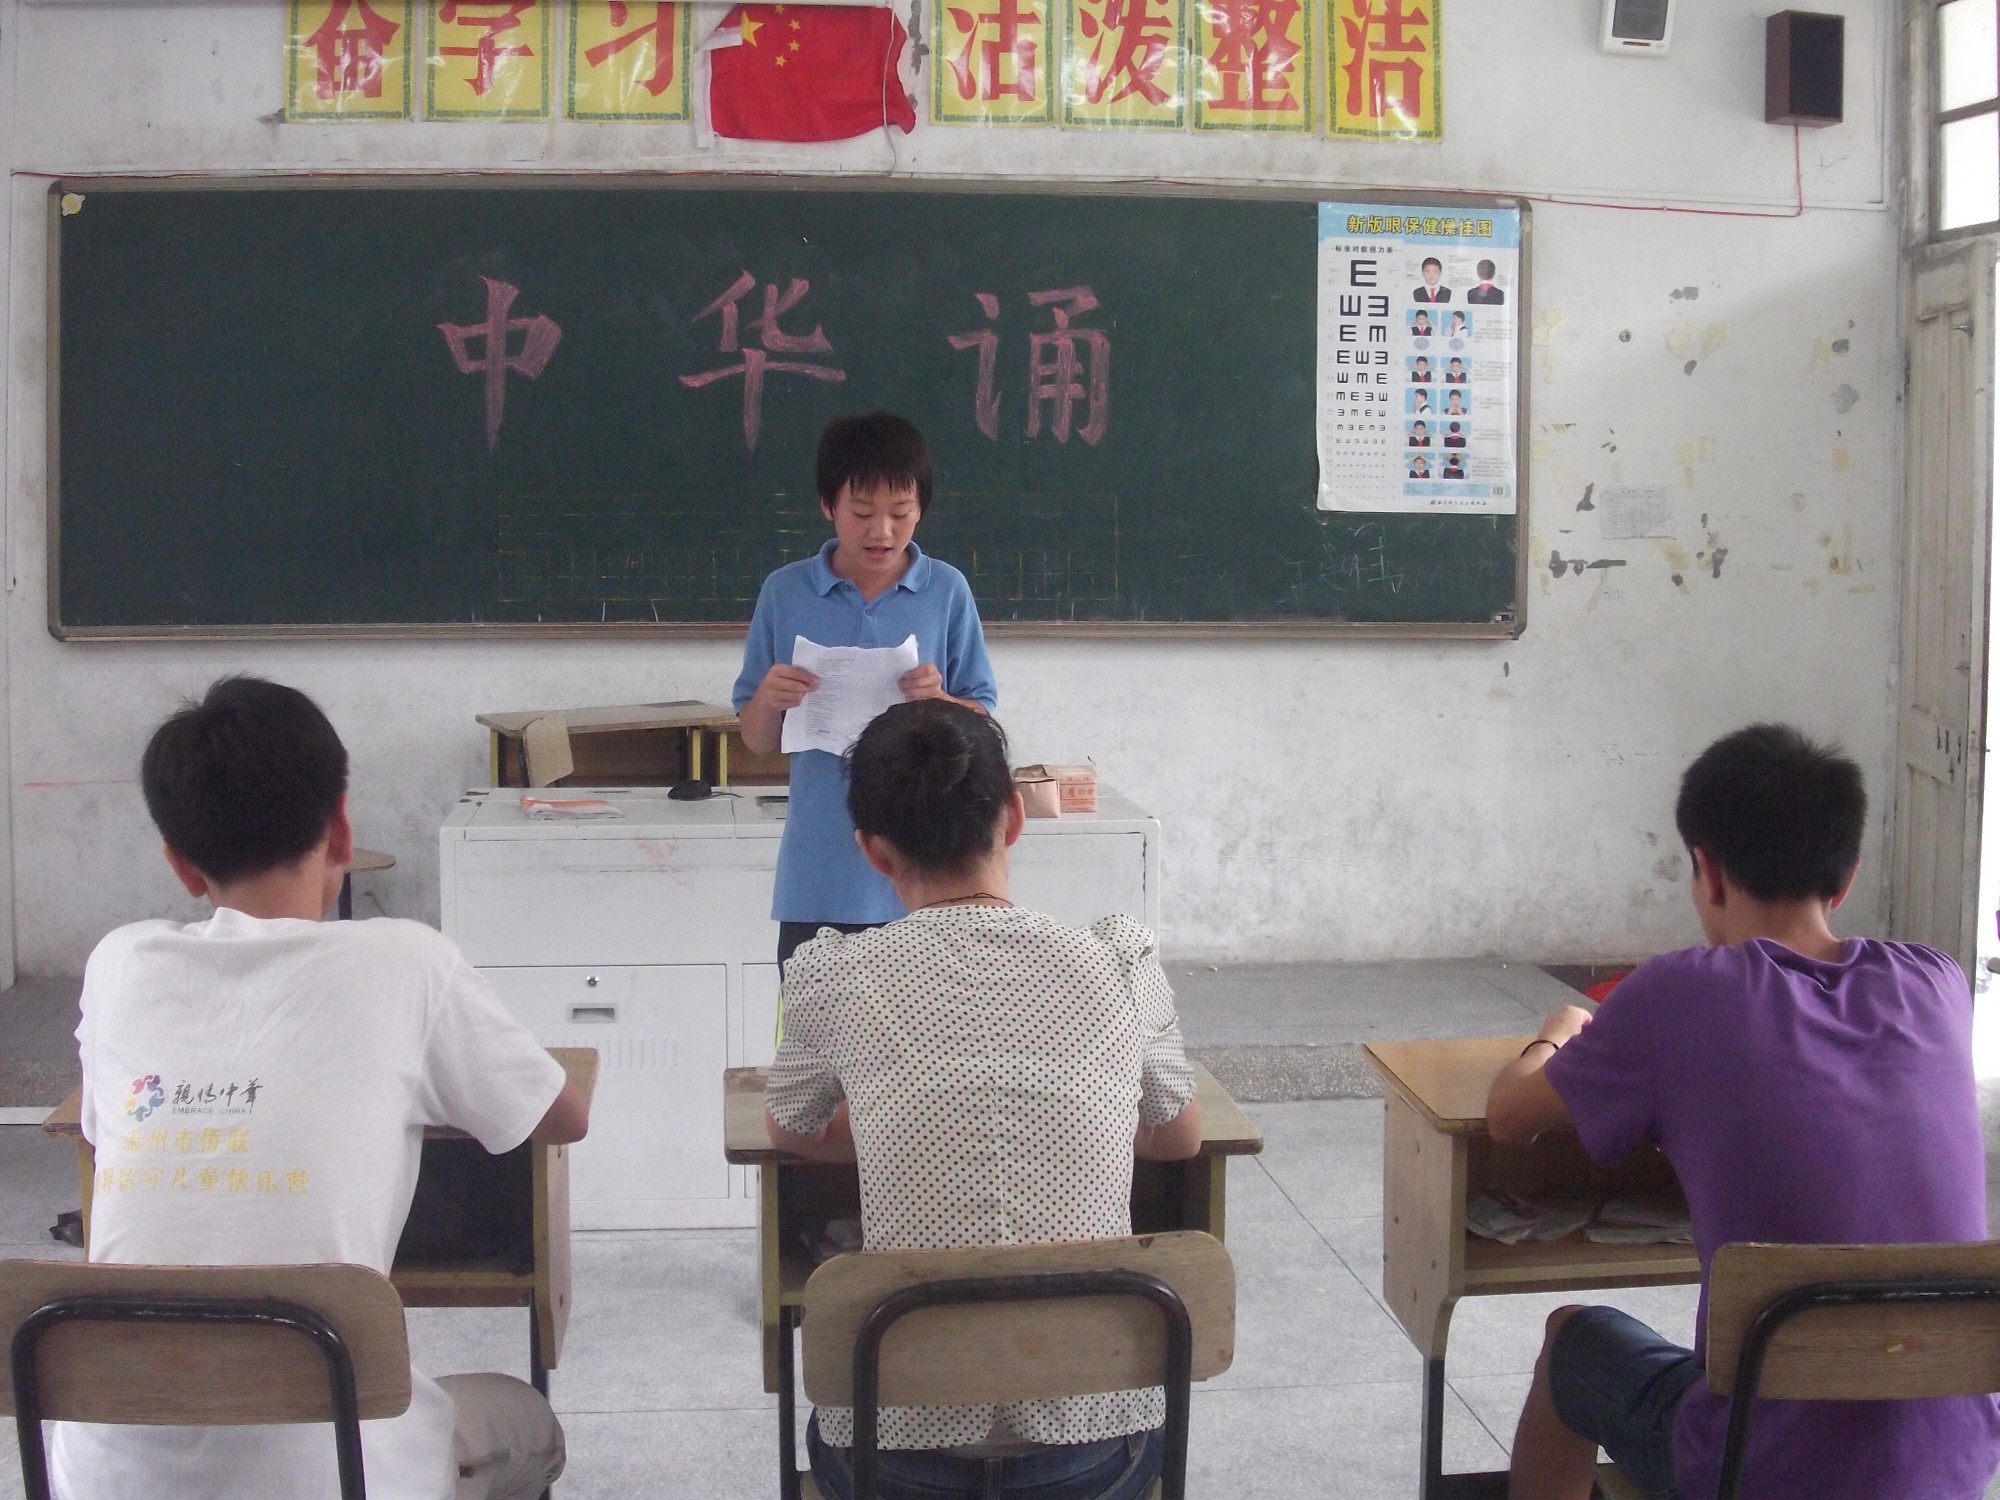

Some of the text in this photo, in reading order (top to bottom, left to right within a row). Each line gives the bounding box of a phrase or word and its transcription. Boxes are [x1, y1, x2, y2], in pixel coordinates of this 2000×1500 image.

[1346, 215, 1494, 238] 新版眼保健操挂图
[436, 270, 1111, 453] 中华诵
[172, 1106, 247, 1115] EMBRACE CHINA
[123, 1127, 250, 1153] 温州市侨联
